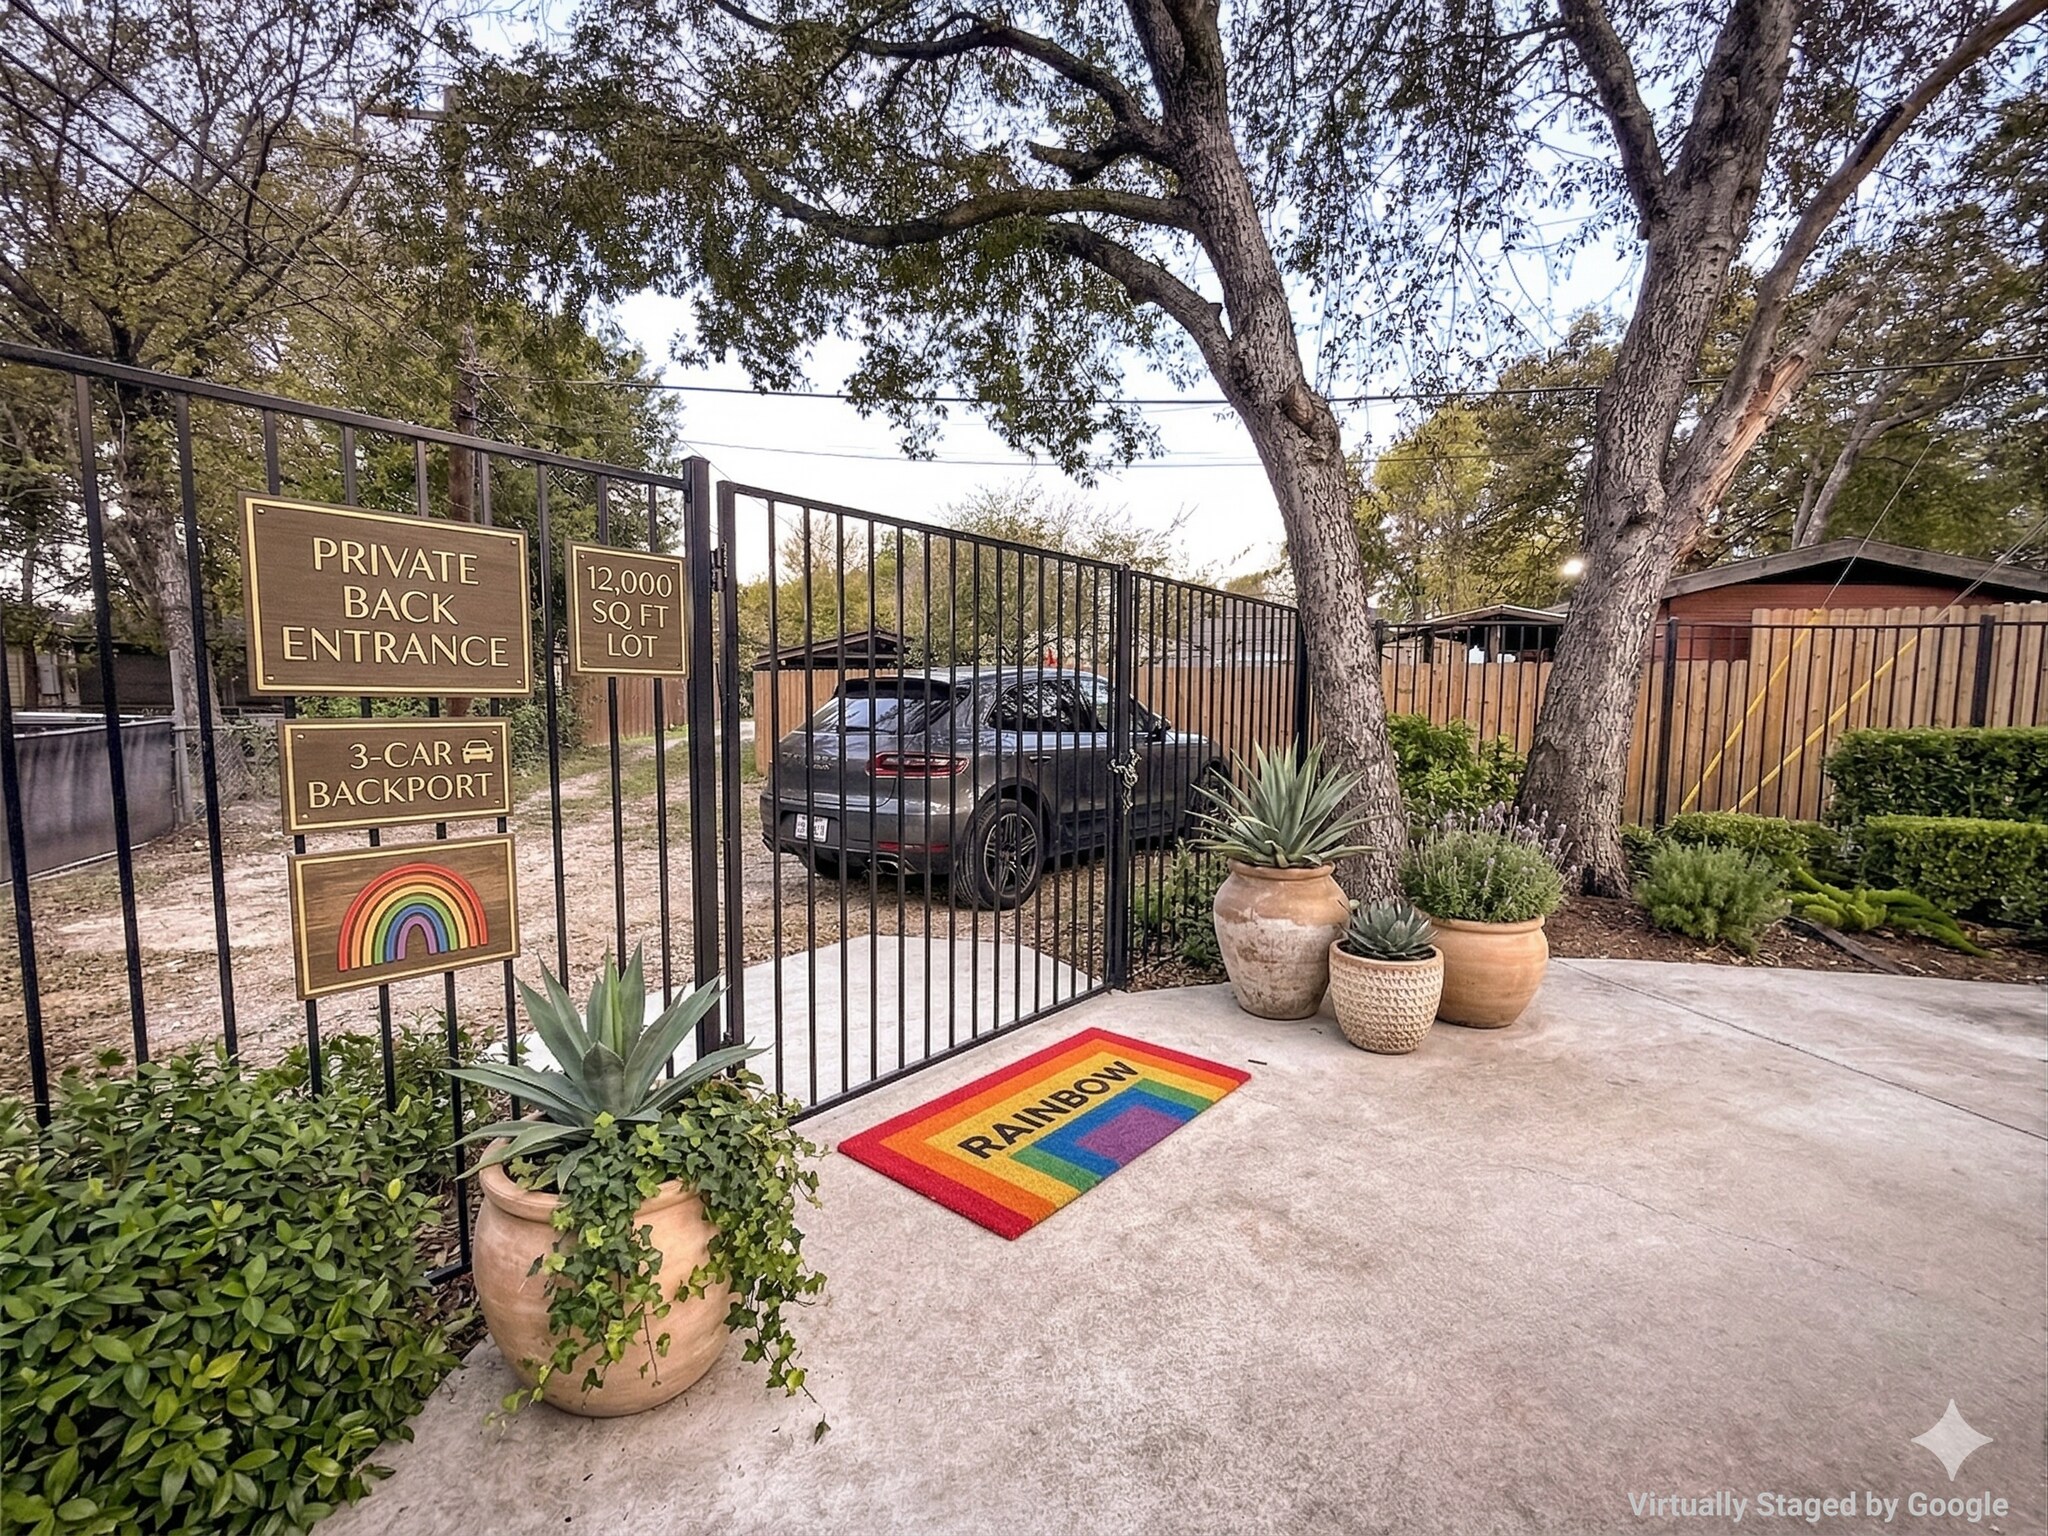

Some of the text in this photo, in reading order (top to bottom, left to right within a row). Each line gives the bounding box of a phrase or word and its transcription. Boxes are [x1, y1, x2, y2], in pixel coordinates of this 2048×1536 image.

[312, 536, 480, 586] PRIVATE
[587, 565, 674, 599] 12,000
[343, 585, 459, 626] BACK
[592, 599, 670, 631] SQ FT
[281, 626, 510, 667] ENTRANCE
[606, 633, 658, 659] LOT
[349, 740, 454, 770] 3-CAR
[308, 772, 494, 810] BACKPORT
[957, 1060, 1139, 1159] RAINBOW
